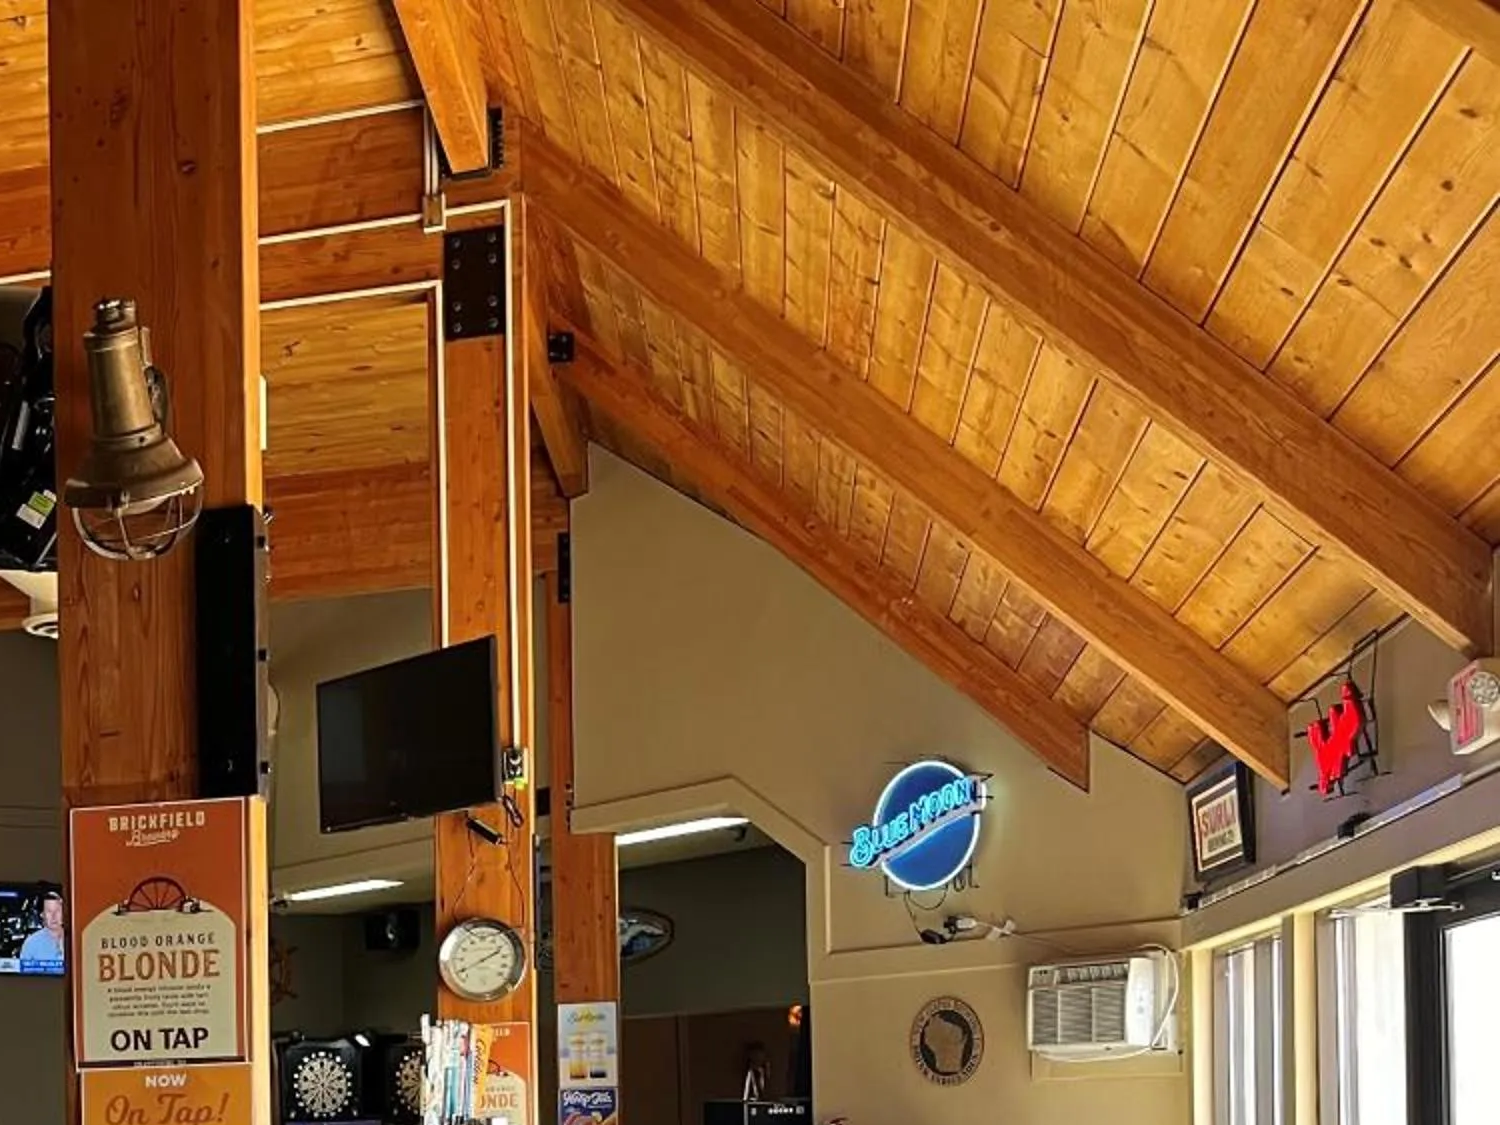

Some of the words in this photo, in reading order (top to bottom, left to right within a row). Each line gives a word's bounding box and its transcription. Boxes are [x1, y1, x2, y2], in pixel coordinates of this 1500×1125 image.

[108, 811, 206, 832] BRICKFIELD
[850, 812, 909, 867] BLUE
[909, 777, 974, 832] MOON
[101, 936, 149, 949] BLOOD
[155, 932, 216, 947] ORANGE
[97, 949, 221, 983] BLONDE
[110, 1029, 152, 1051] ON
[159, 1027, 209, 1050] TAP
[145, 1074, 187, 1088] NOW
